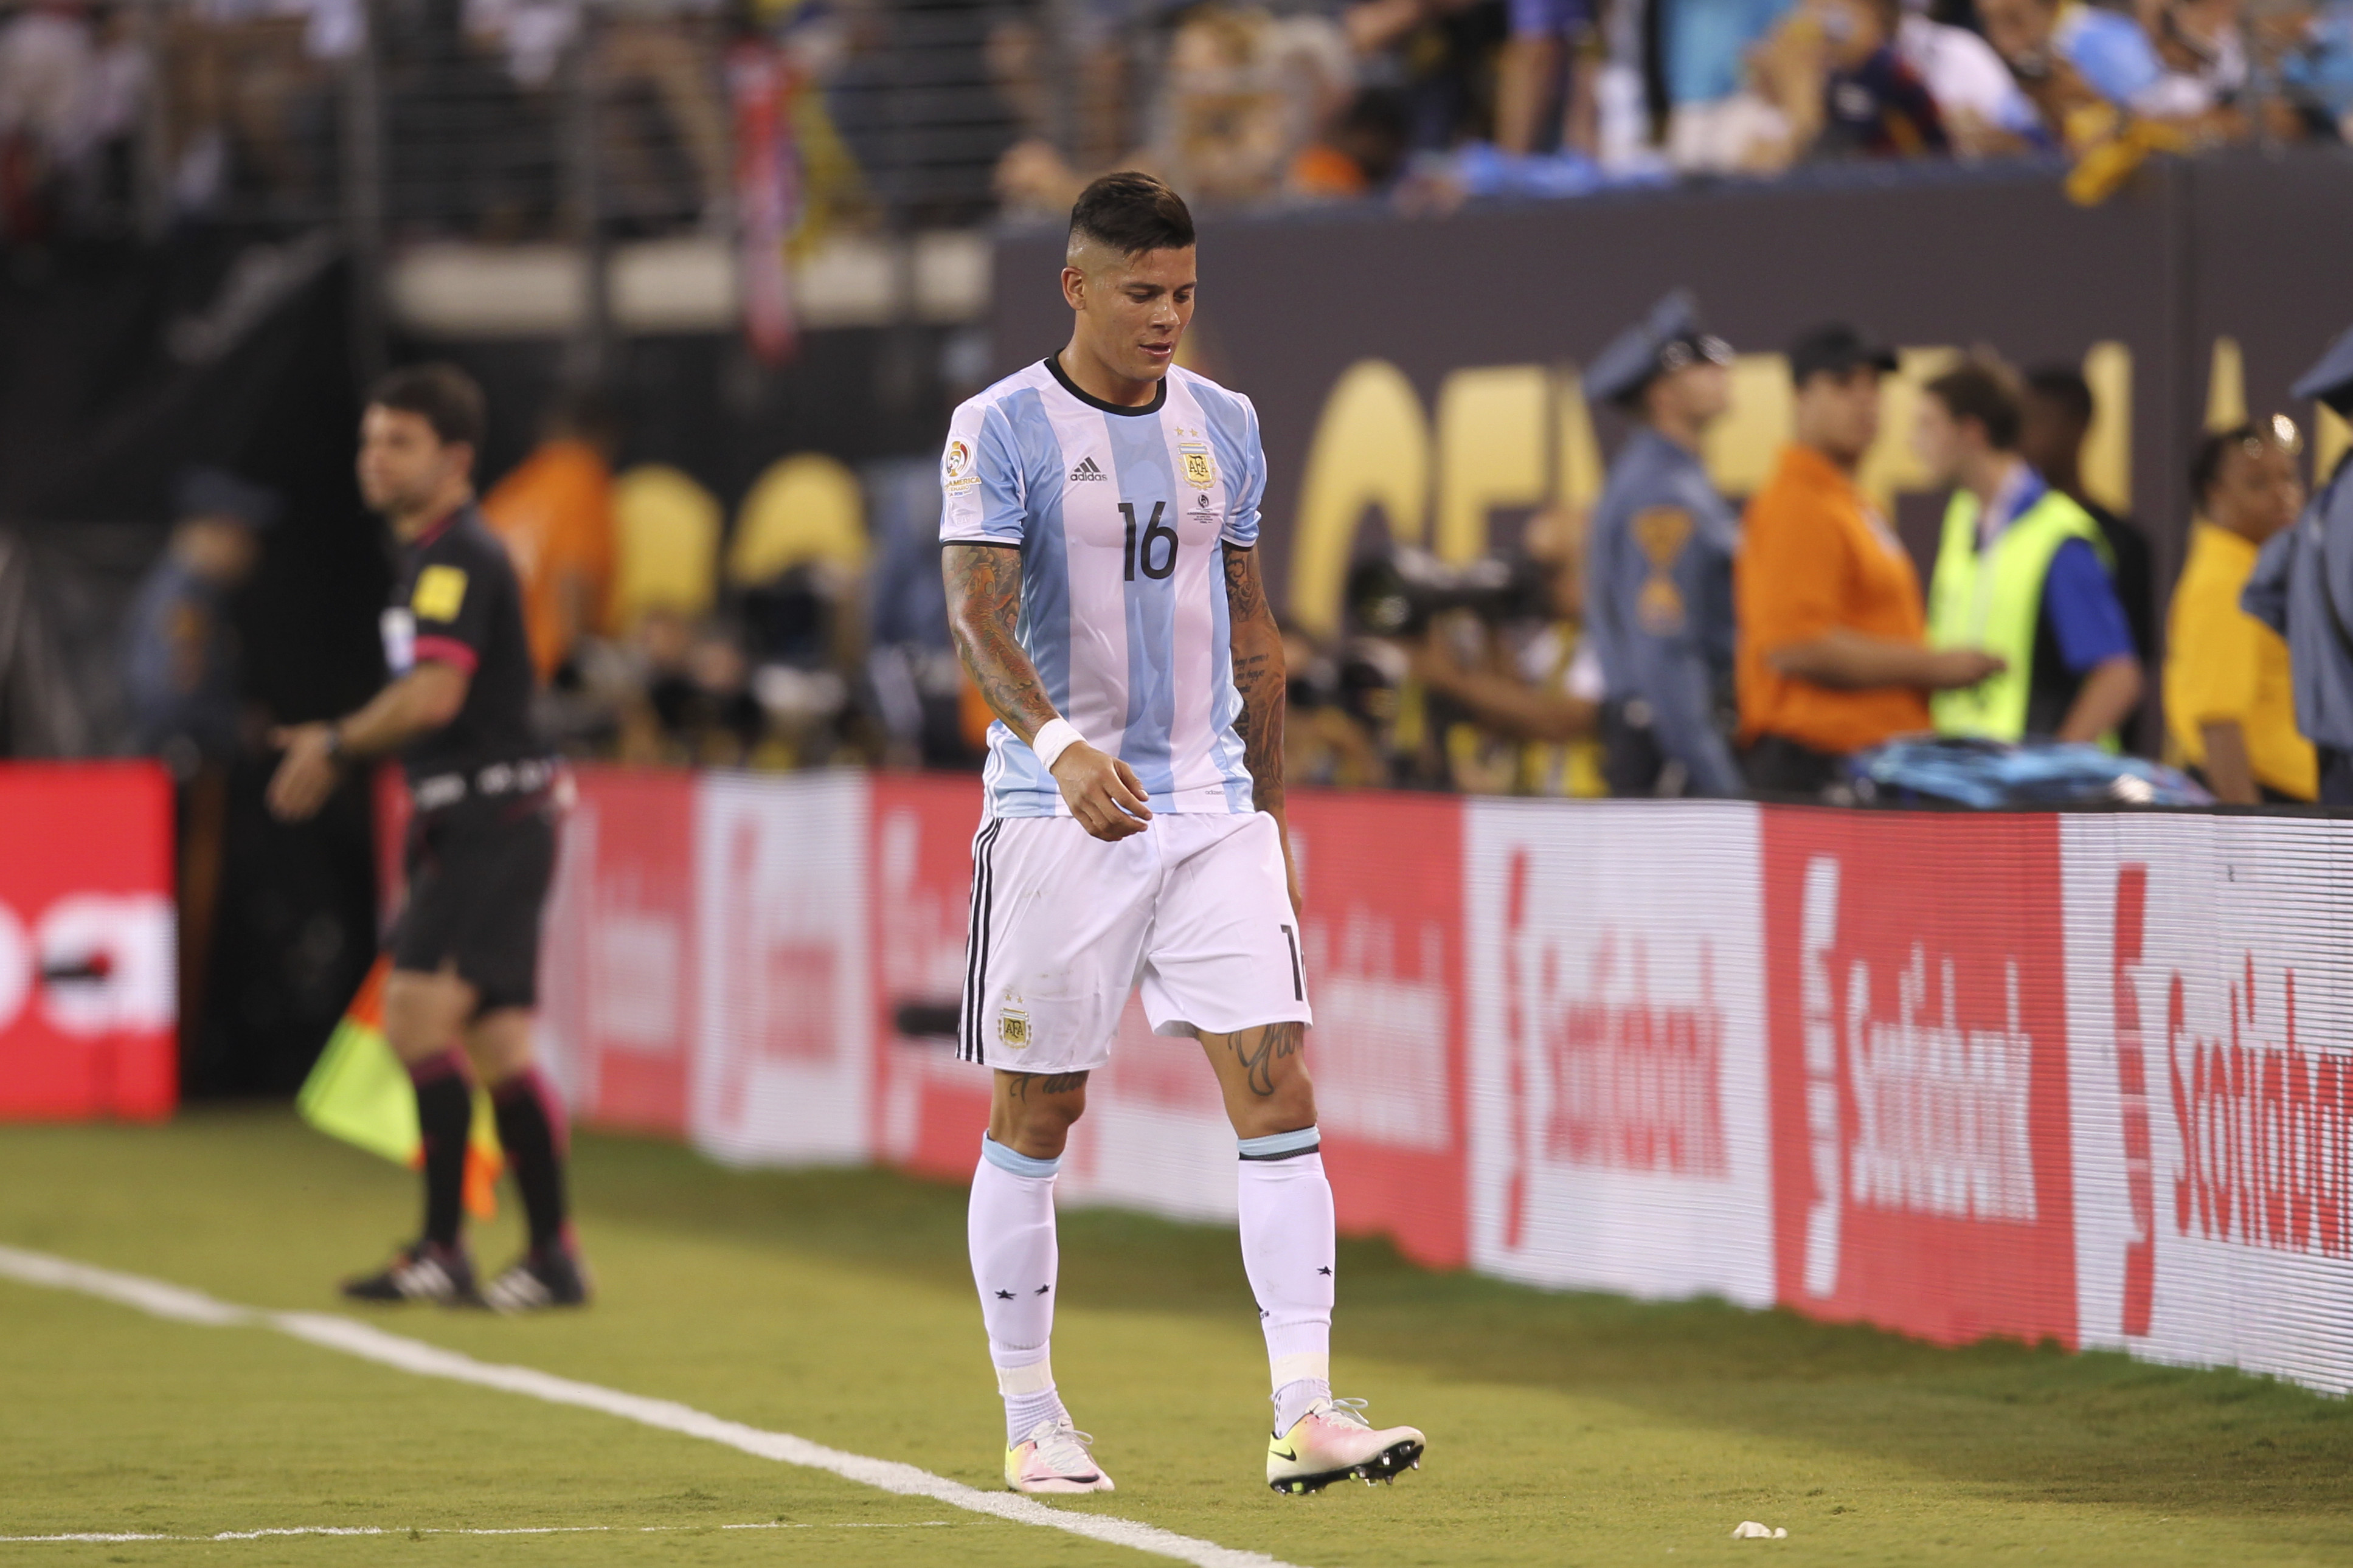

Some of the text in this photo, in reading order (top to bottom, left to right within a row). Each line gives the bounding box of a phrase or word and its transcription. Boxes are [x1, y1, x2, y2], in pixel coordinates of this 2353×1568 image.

[1070, 472, 1107, 481] adidas
[1117, 501, 1179, 581] 16
[1280, 924, 1307, 1001] 1
